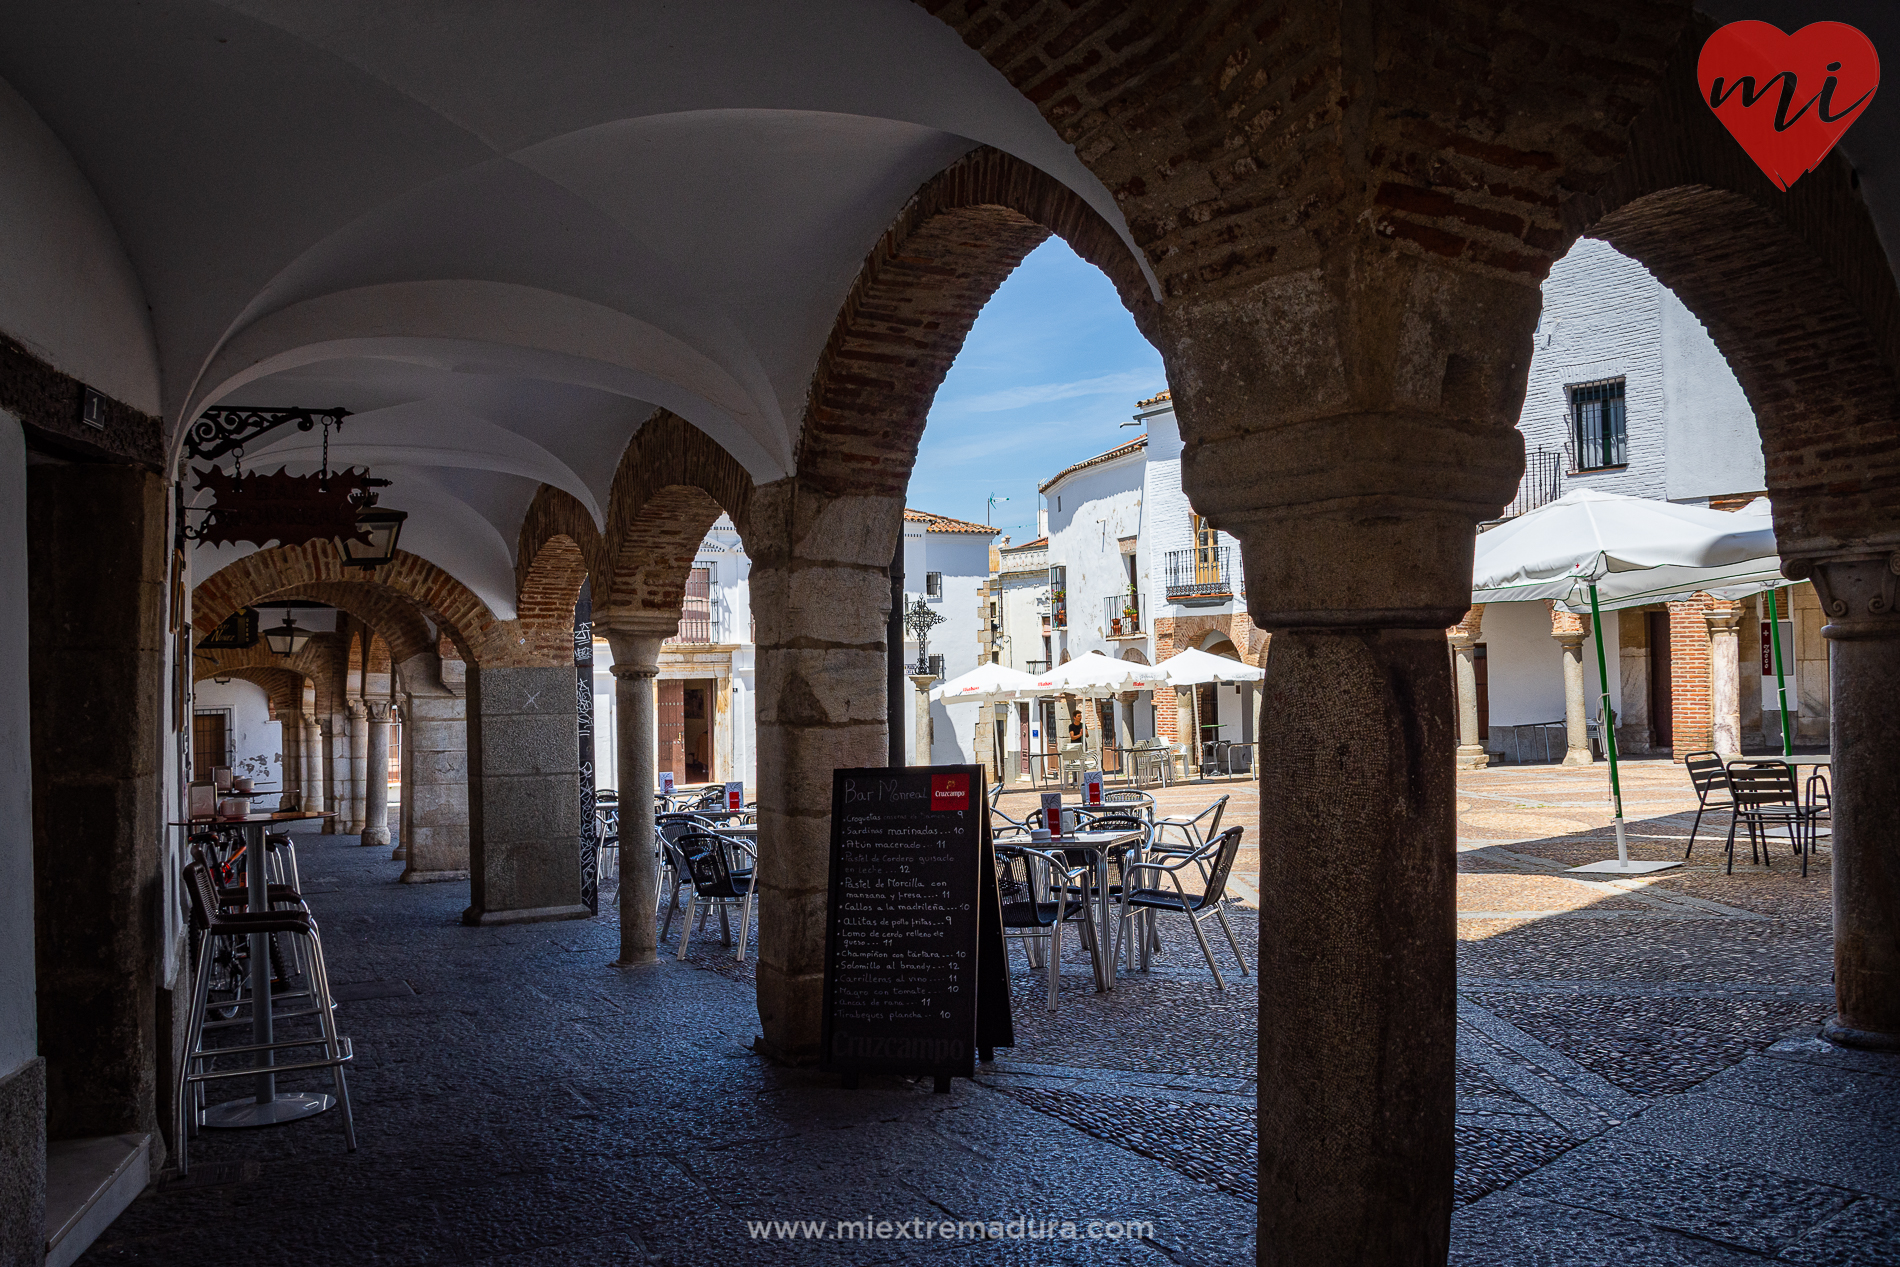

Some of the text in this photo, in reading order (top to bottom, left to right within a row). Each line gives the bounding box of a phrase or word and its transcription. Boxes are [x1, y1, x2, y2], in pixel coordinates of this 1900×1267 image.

[92, 397, 98, 419] 1
[844, 779, 928, 804] Bar Monreal
[934, 790, 966, 798] Cruzcampo
[846, 813, 881, 825] Croquetas
[957, 810, 964, 819] 9
[846, 826, 883, 835] Sardinas
[887, 825, 938, 836] marinadas
[846, 840, 946, 849] Atún macerado 11
[844, 851, 869, 863] Pastel
[871, 855, 880, 863] de
[918, 854, 955, 864] guisado
[900, 865, 910, 873] 12
[844, 877, 871, 889] Pastel
[875, 880, 885, 888] de
[887, 879, 925, 888] Morcilla
[890, 892, 896, 901] y
[844, 904, 873, 912] Callos
[885, 903, 895, 911] la
[898, 903, 945, 912] madrileña
[891, 918, 909, 928] pollo
[945, 916, 952, 926] 9
[842, 929, 944, 938] Lomo de cerdo relleno de
[843, 939, 866, 949] queso
[840, 960, 960, 972] Solomillo al brandy 12
[839, 974, 892, 983] Carrilleras
[895, 974, 905, 983] al
[908, 974, 928, 983] vino
[839, 987, 869, 999] Magro
[947, 985, 959, 993] 10
[870, 998, 880, 1006] de
[921, 998, 931, 1006] 11
[837, 1009, 884, 1022] Tirabeques
[889, 1010, 923, 1021] plancha
[833, 1031, 965, 1064] Cruzcampo
